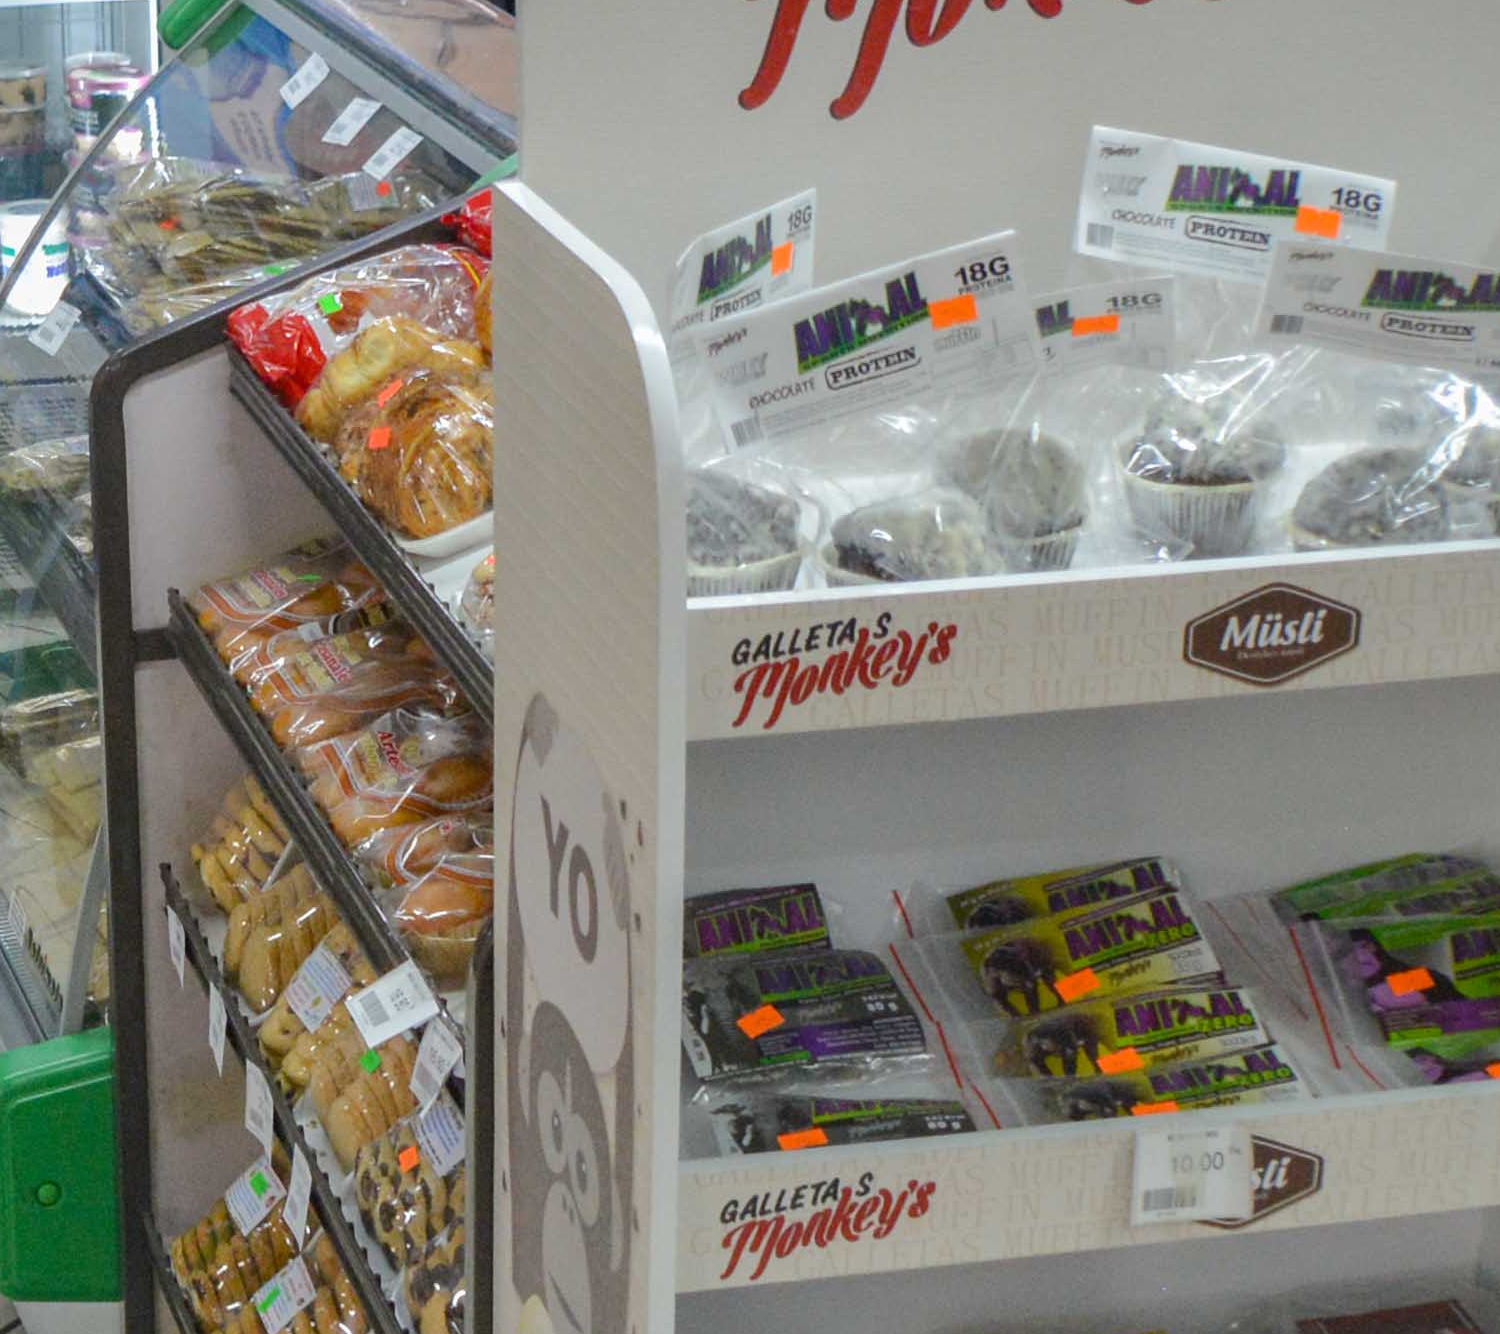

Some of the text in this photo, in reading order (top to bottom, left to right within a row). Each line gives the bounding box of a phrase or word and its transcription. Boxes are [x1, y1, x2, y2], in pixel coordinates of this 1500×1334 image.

[1330, 186, 1383, 213] 18G
[787, 204, 813, 231] 18G
[1191, 221, 1271, 245] PROTEIN
[954, 255, 1011, 288] 18G
[957, 275, 1013, 296] PROTEINA
[1106, 292, 1163, 309] 18G
[1386, 317, 1475, 339] PROTEIN
[831, 347, 918, 387] PROTEIN
[732, 612, 892, 665] GALLETAS
[1219, 606, 1327, 654] Müsli
[732, 621, 958, 729] Monkey's
[540, 795, 602, 963] YO
[1170, 1150, 1225, 1174] 10.00
[720, 1172, 875, 1226] GALLETAS
[720, 1179, 937, 1282] Monkey's
